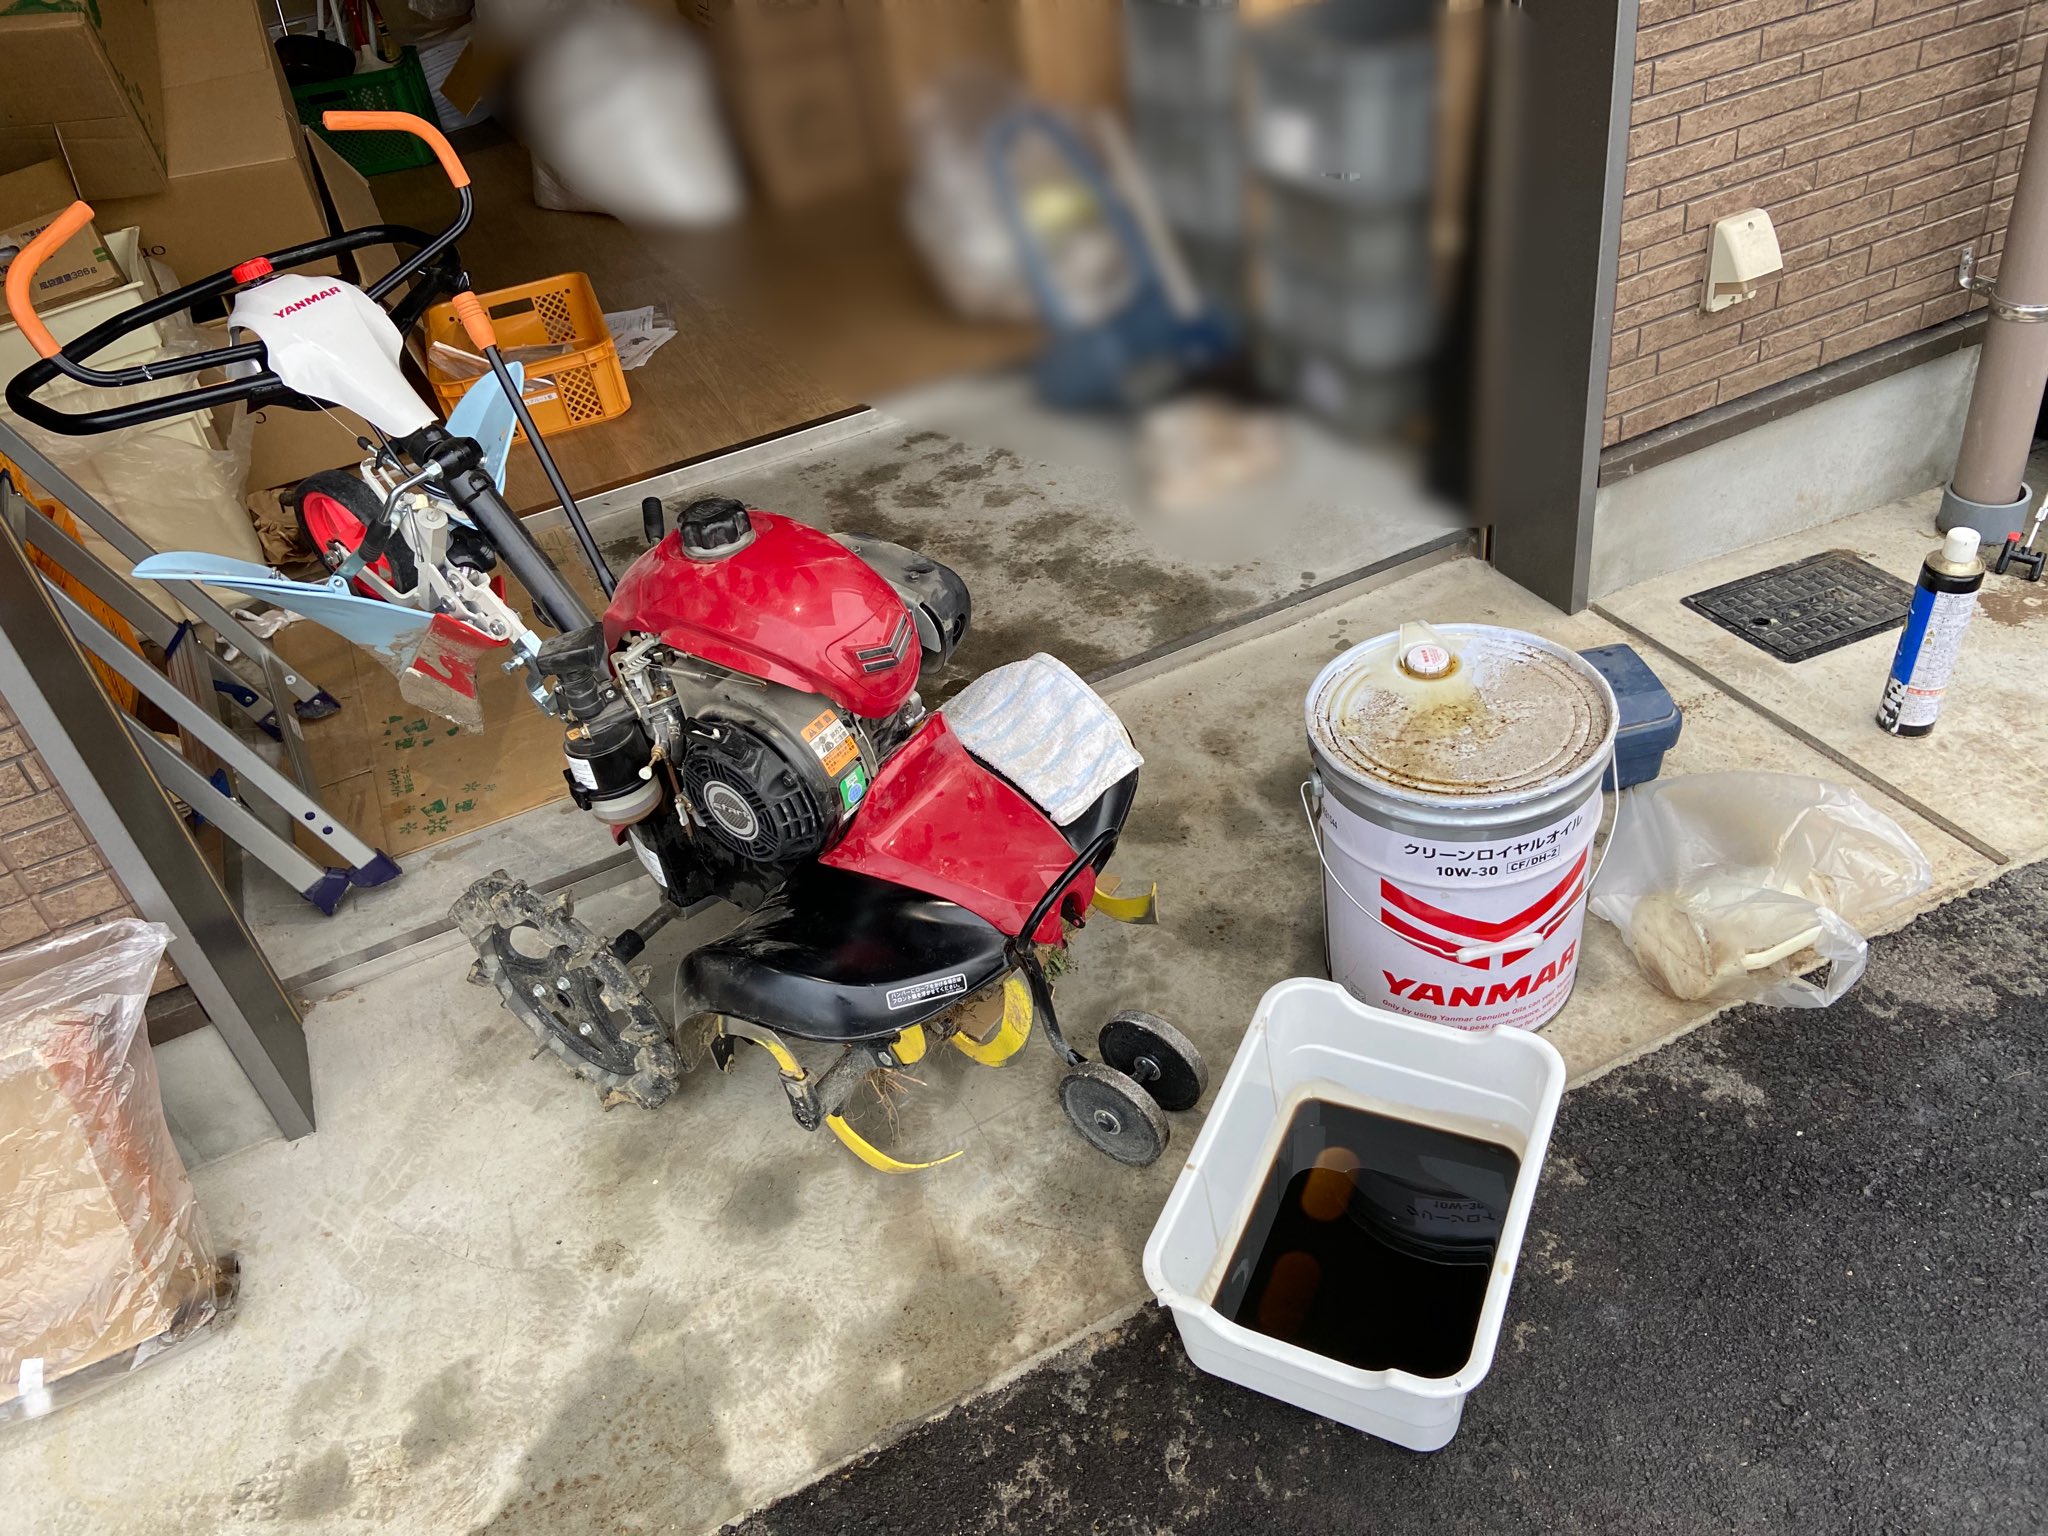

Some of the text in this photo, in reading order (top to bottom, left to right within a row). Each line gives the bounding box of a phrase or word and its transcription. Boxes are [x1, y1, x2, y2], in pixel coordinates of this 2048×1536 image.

[273, 286, 341, 318] YANMAR
[1404, 815, 1583, 862] クリーンロイヤルオイル
[1436, 848, 1558, 877] 10W-30 CF/DH-2
[1382, 939, 1577, 1007] YANMAR
[1382, 999, 1400, 1011] Only
[1402, 1007, 1412, 1015] by
[1414, 1011, 1437, 1021] using
[1476, 1011, 1510, 1022] Genuine
[1512, 1006, 1527, 1015] Oils
[1528, 999, 1541, 1009] can
[1469, 1023, 1490, 1032] peak
